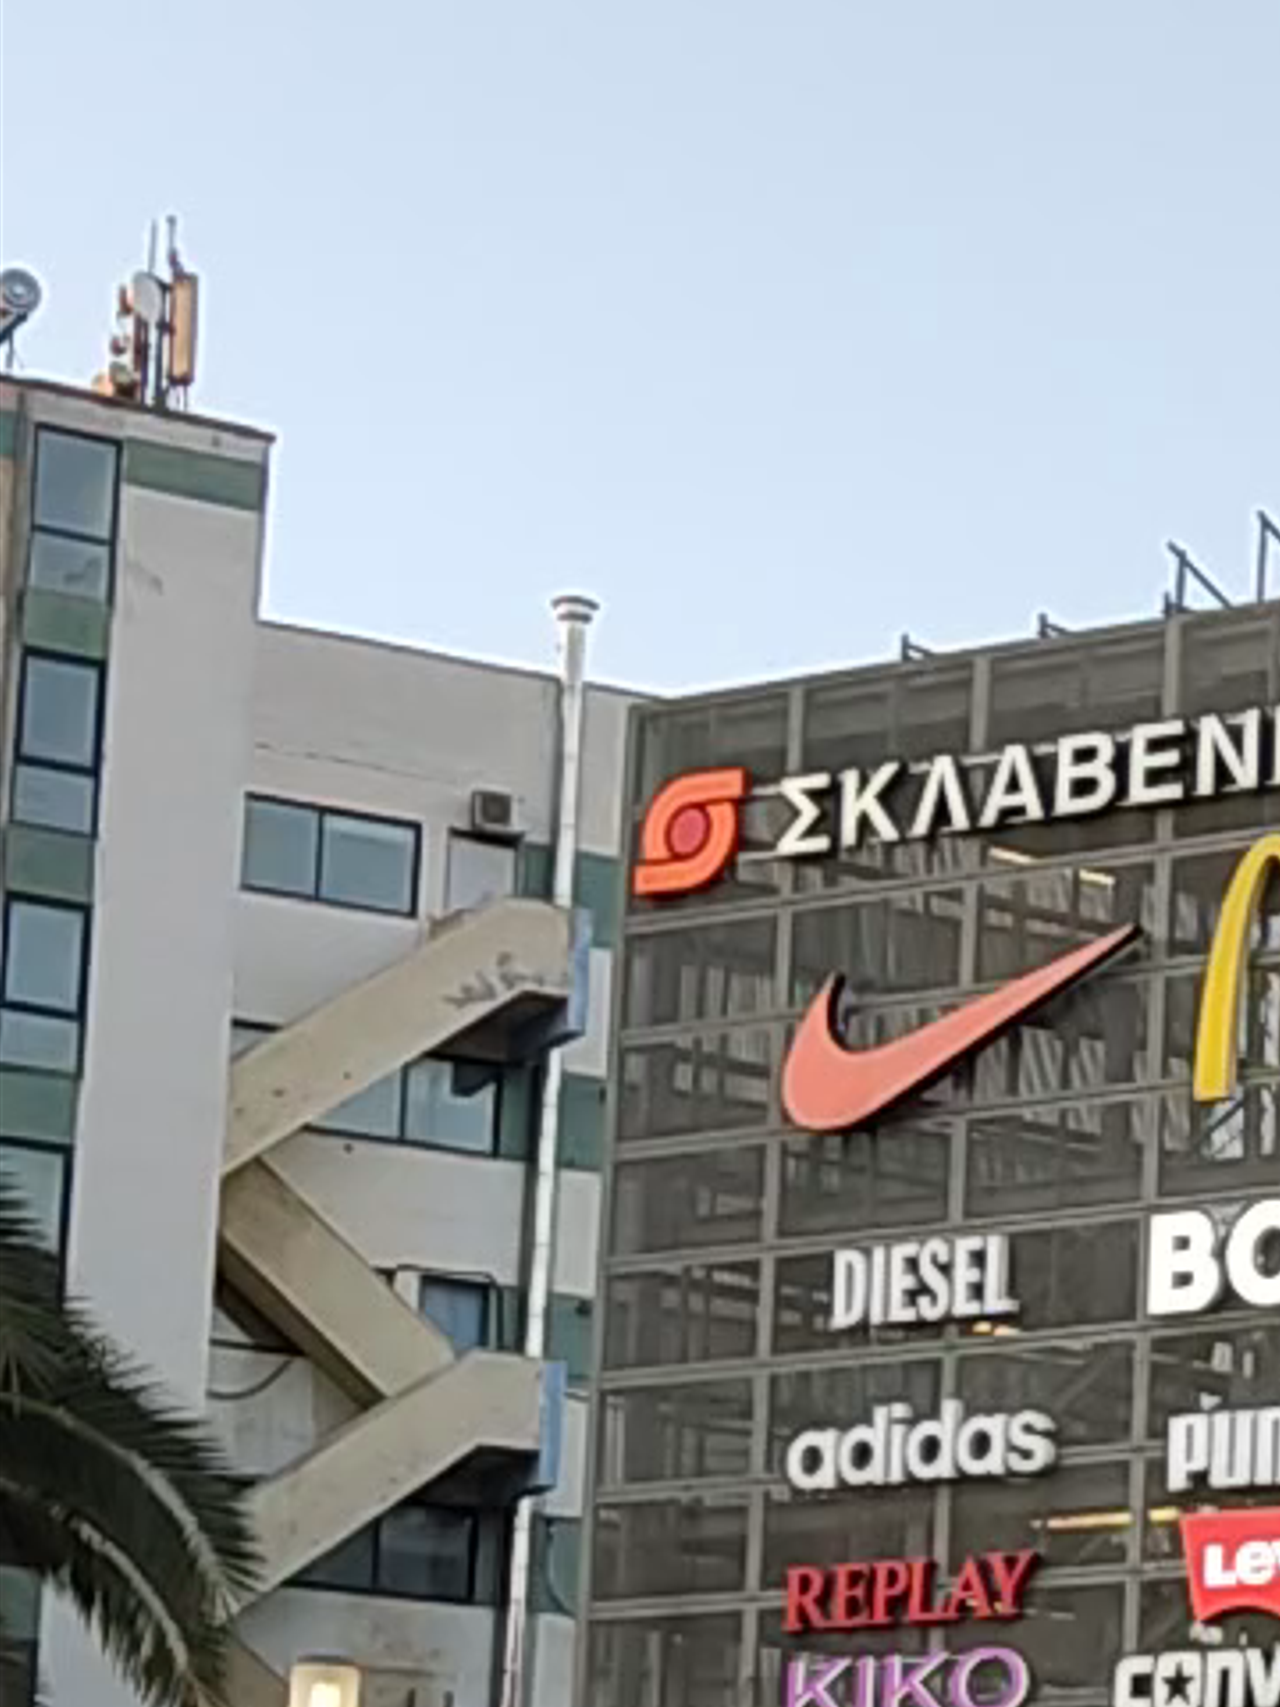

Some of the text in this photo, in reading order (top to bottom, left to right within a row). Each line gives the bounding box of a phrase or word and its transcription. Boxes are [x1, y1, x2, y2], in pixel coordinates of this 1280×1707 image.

[831, 1234, 1020, 1331] DIESEL
[786, 1398, 1058, 1491] adidas
[781, 1549, 1040, 1633] REPLAY
